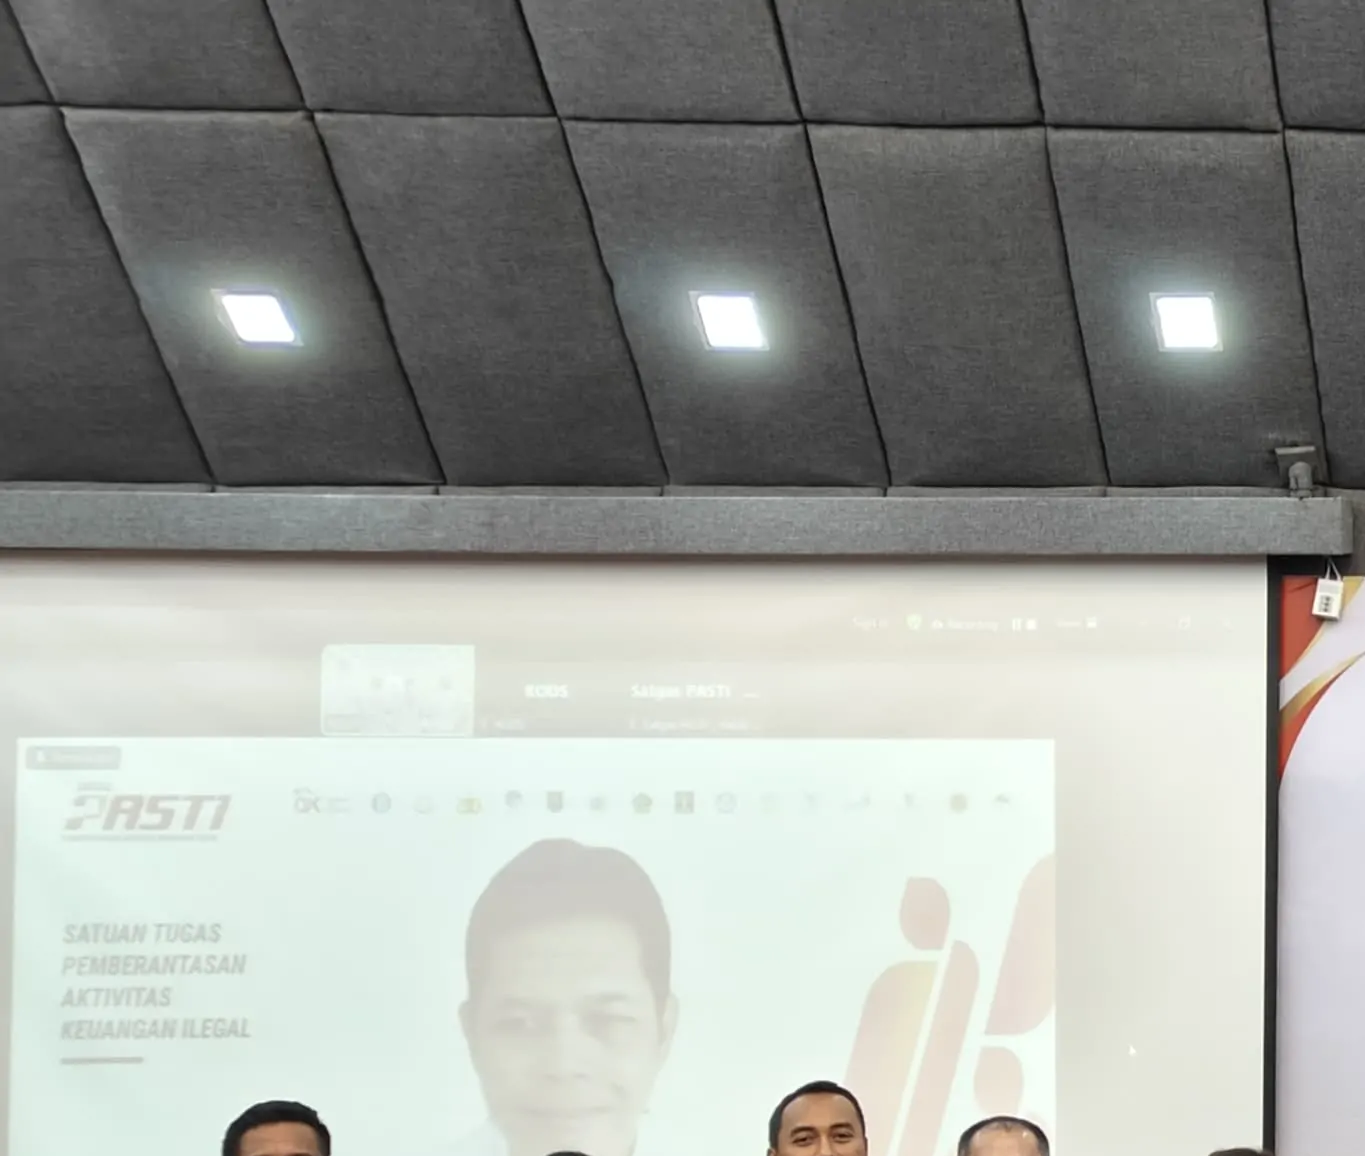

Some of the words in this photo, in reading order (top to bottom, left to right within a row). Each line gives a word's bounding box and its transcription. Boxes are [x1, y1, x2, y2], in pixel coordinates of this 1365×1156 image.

[63, 793, 233, 832] PASTI
[62, 922, 147, 945] SATUAN
[153, 922, 223, 944] TUGAS
[61, 953, 248, 977] PEMBERANTASAN
[60, 985, 174, 1008] AKTIVITAS
[60, 1017, 177, 1041] KEUANGAN
[181, 1016, 252, 1039] ILEGAL
